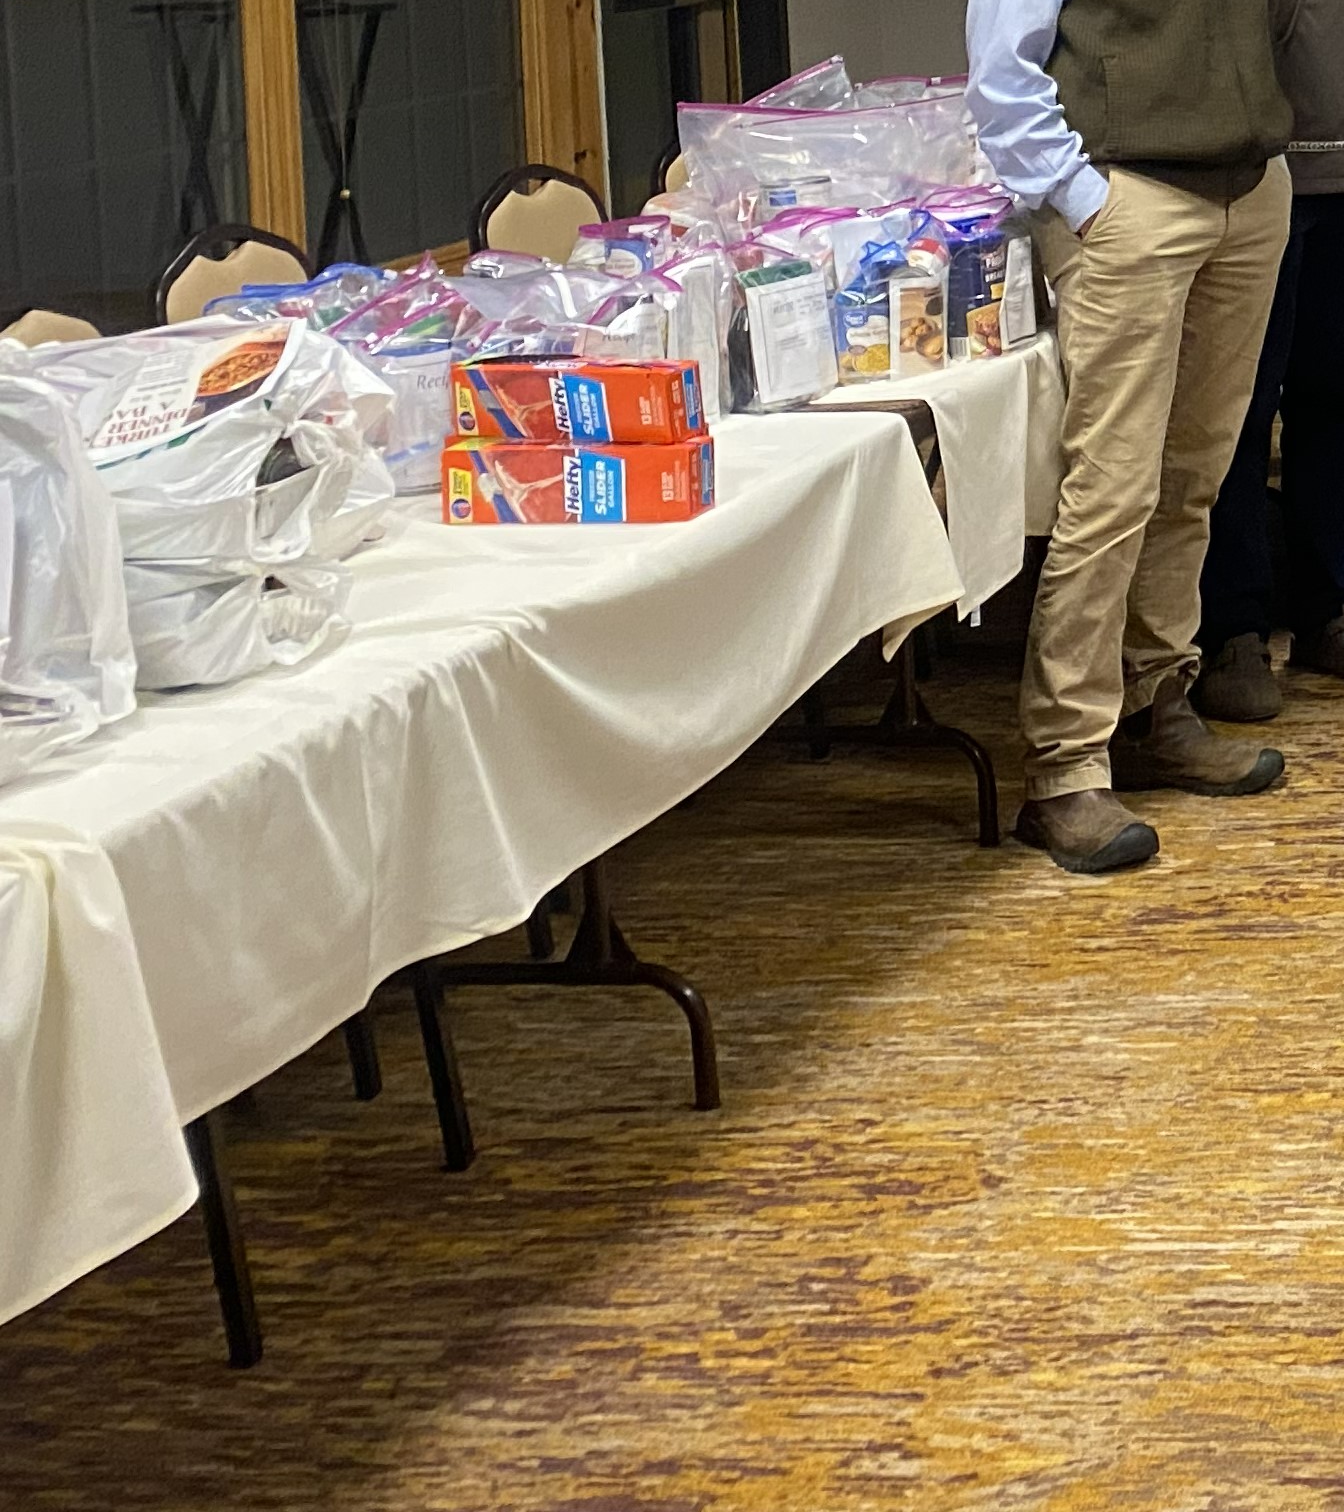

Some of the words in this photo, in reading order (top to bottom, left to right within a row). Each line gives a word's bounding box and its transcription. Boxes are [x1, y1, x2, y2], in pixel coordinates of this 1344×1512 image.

[553, 379, 571, 430] Hefty
[578, 383, 594, 436] SLIDER
[565, 459, 583, 511] Hefty
[595, 460, 607, 516] SLIDER
